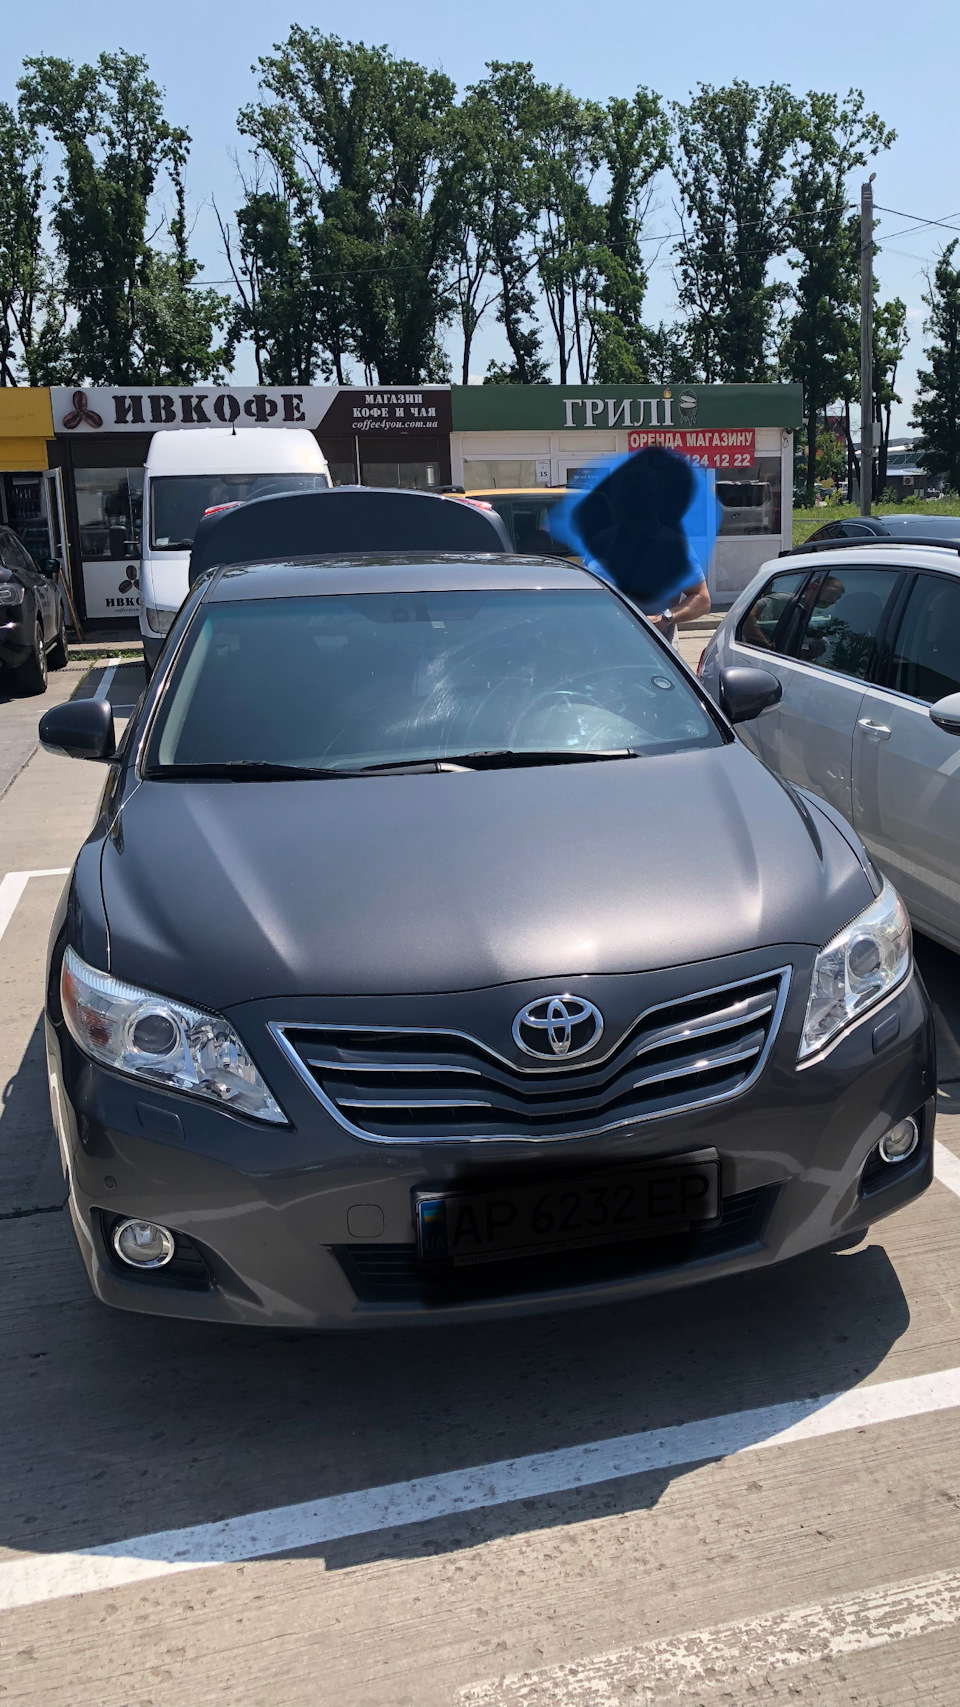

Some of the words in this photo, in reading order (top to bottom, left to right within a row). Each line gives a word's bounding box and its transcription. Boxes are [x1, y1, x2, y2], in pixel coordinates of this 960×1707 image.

[364, 394, 423, 404] МАГАЗИН
[112, 394, 306, 424] ИВКОФЕ
[352, 407, 389, 418] КОФЕ
[395, 407, 405, 417] И
[410, 407, 437, 417] ЧАЯ
[563, 396, 675, 427] ГРИЛІ
[352, 419, 438, 430] coffee4you.com.ua
[630, 433, 683, 449] ОРЕНДА
[686, 431, 753, 447] МАГАЗИНУ
[684, 454, 708, 467] 124
[713, 454, 729, 467] 12
[733, 453, 751, 467] 22
